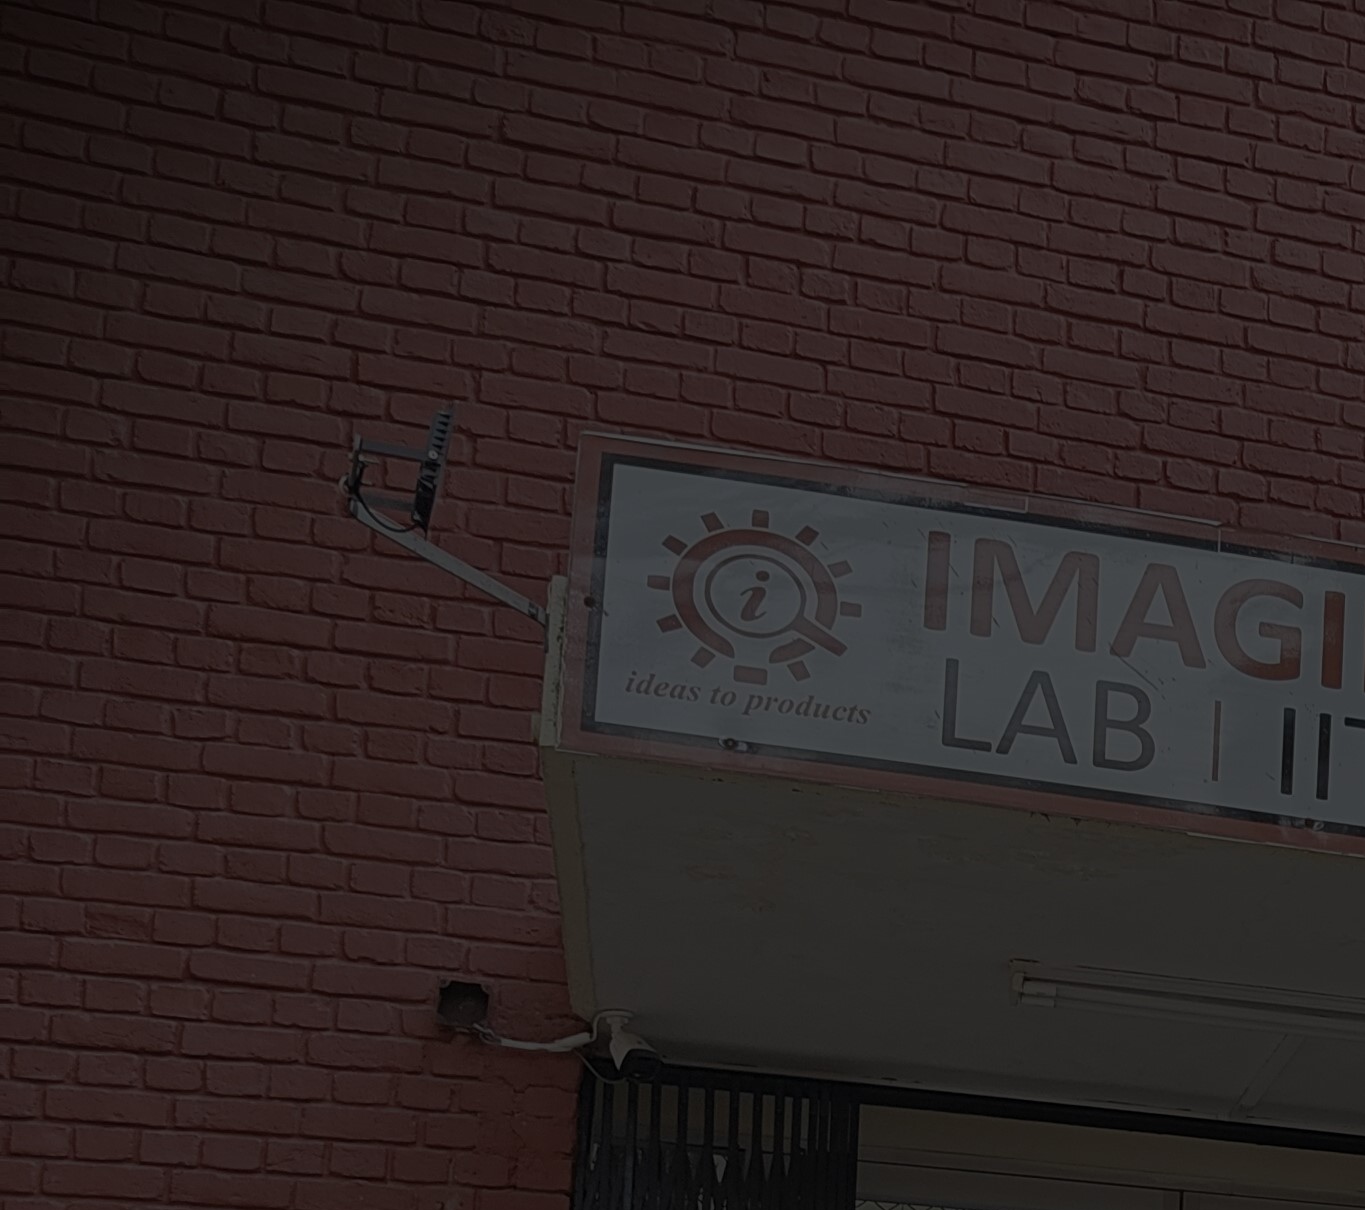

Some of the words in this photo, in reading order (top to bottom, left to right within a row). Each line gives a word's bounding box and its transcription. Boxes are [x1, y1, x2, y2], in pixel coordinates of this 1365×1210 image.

[624, 669, 702, 706] ideas
[709, 685, 738, 709] to
[740, 687, 872, 726] products
[941, 658, 1156, 772] LAB
